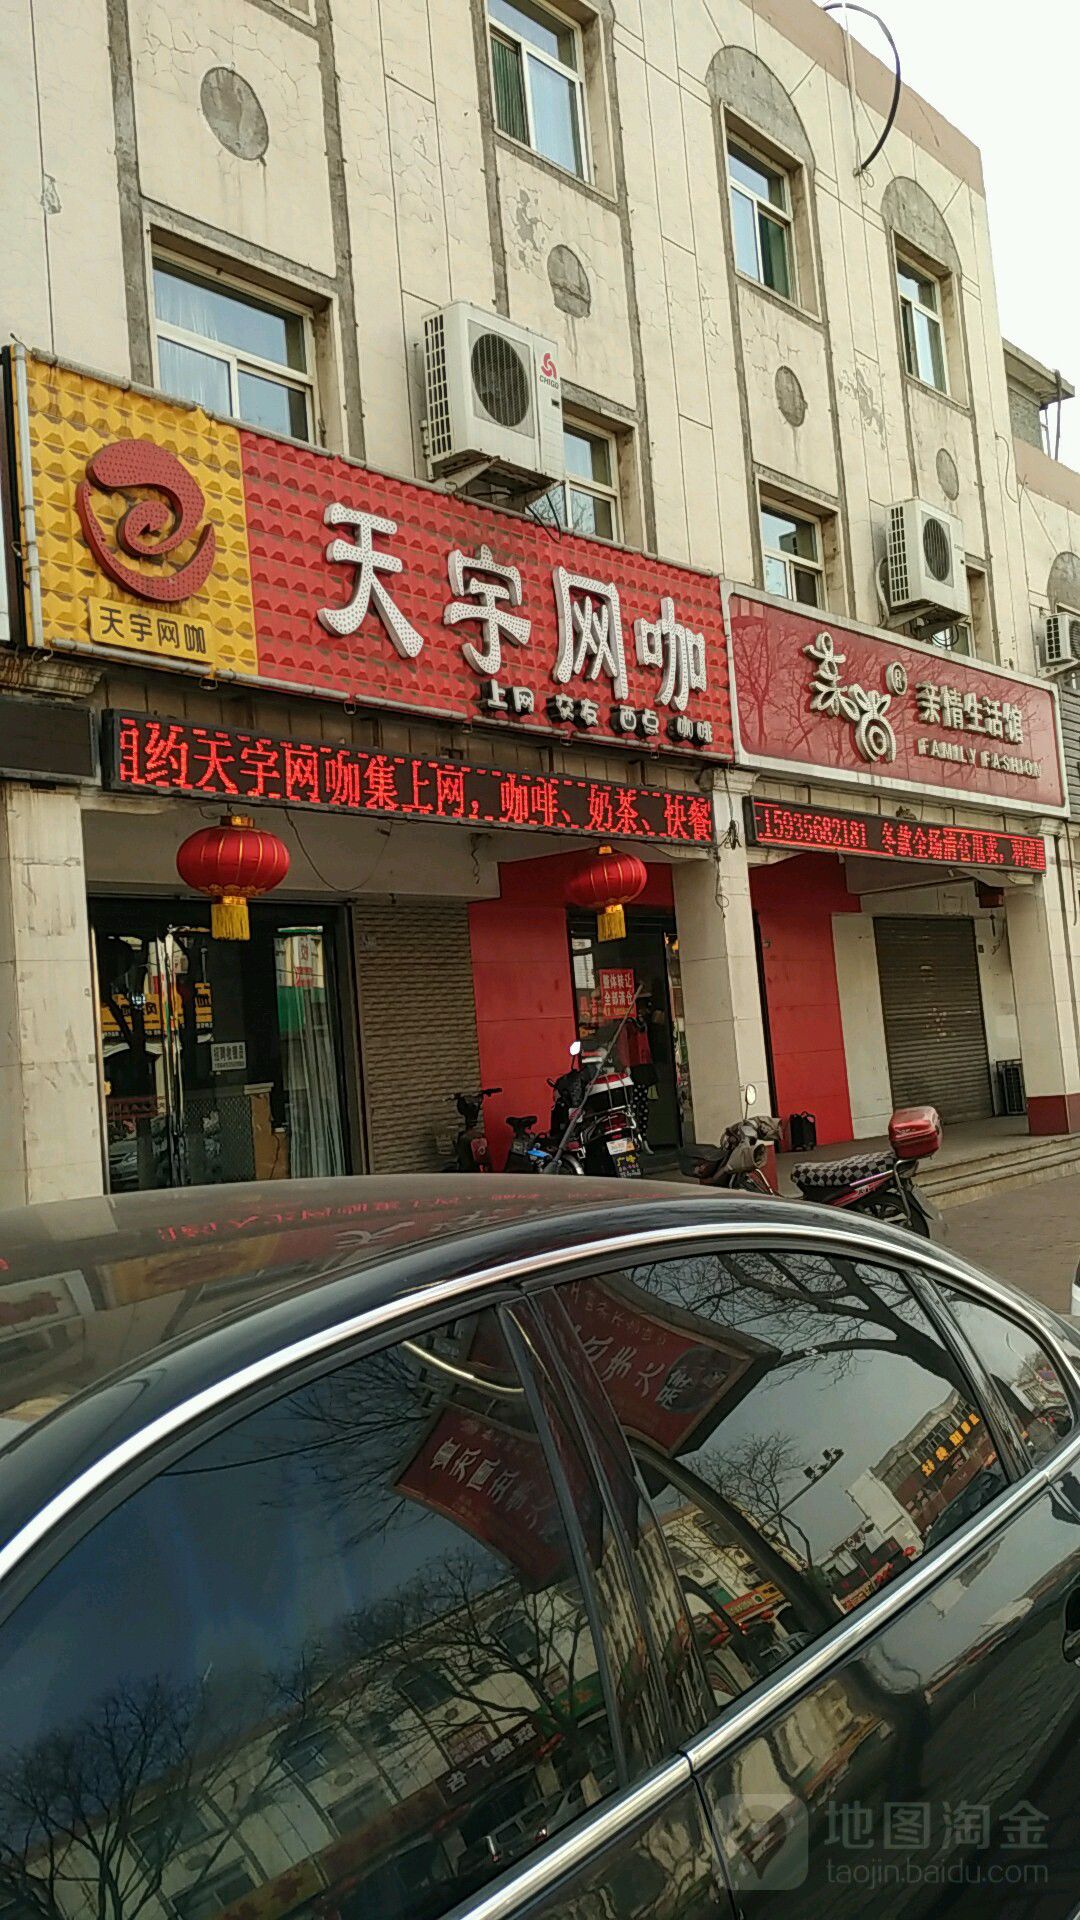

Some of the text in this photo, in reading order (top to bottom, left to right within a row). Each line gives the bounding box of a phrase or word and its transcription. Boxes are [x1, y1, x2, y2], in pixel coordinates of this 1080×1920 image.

[540, 374, 559, 389] CHIGO
[99, 605, 207, 655] 天宇网咖
[316, 502, 708, 712] 天宇网咖
[487, 678, 714, 745] 上网 交友 西点 咖啡
[915, 680, 1024, 744] 亲情生活馆
[918, 737, 1040, 778] FAMILY FASHION
